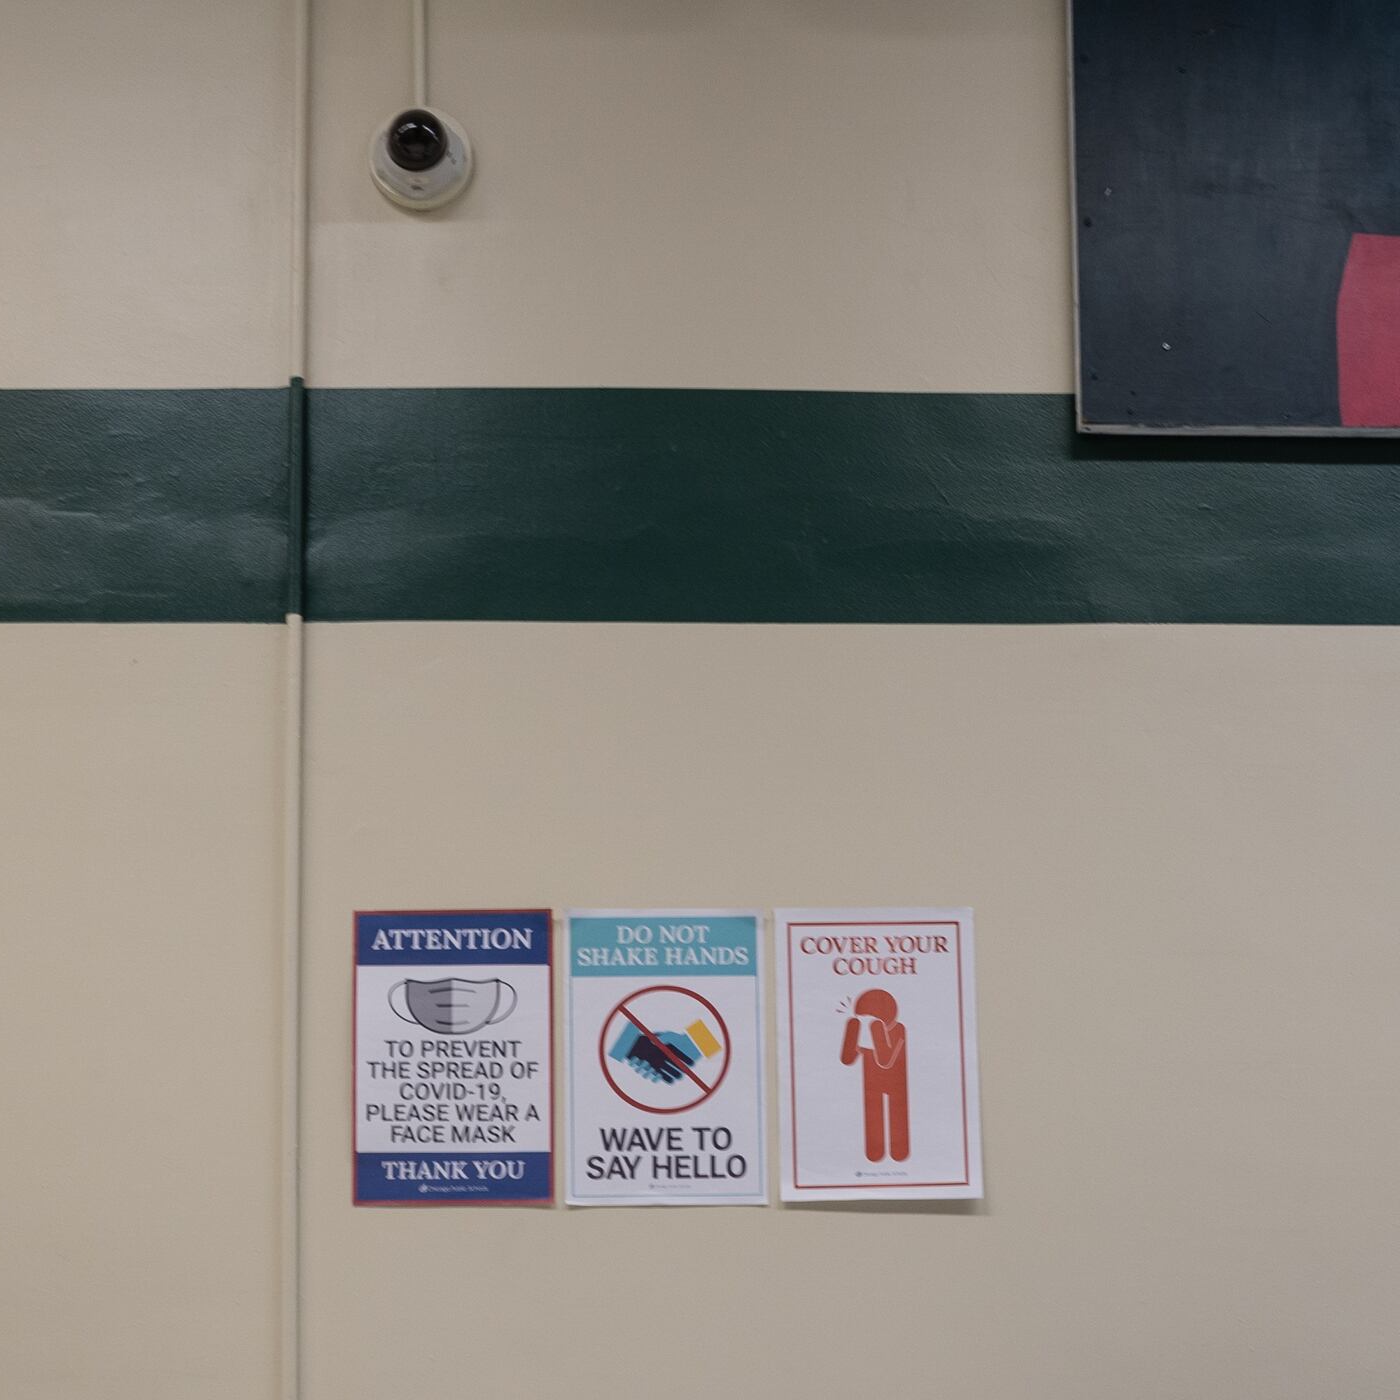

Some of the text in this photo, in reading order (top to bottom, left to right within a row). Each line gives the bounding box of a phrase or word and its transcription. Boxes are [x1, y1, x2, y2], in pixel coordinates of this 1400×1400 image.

[371, 928, 532, 951] ATTENTION
[616, 925, 710, 945] DO NOT
[800, 936, 950, 955] COVER YOUR
[577, 947, 749, 967] SHAKE HANDS
[832, 957, 918, 976] COUGH
[384, 1040, 522, 1059] TO PREVENT
[367, 1061, 539, 1080] THE SPREAD OF
[400, 1082, 507, 1104] COVID-19,
[366, 1104, 540, 1122] PLEASE WEAR A
[391, 1126, 516, 1144] FACE MASK
[599, 1127, 733, 1152] WAVE TO
[381, 1160, 526, 1181] THANK YOU
[586, 1155, 748, 1180] SAY HELLO
